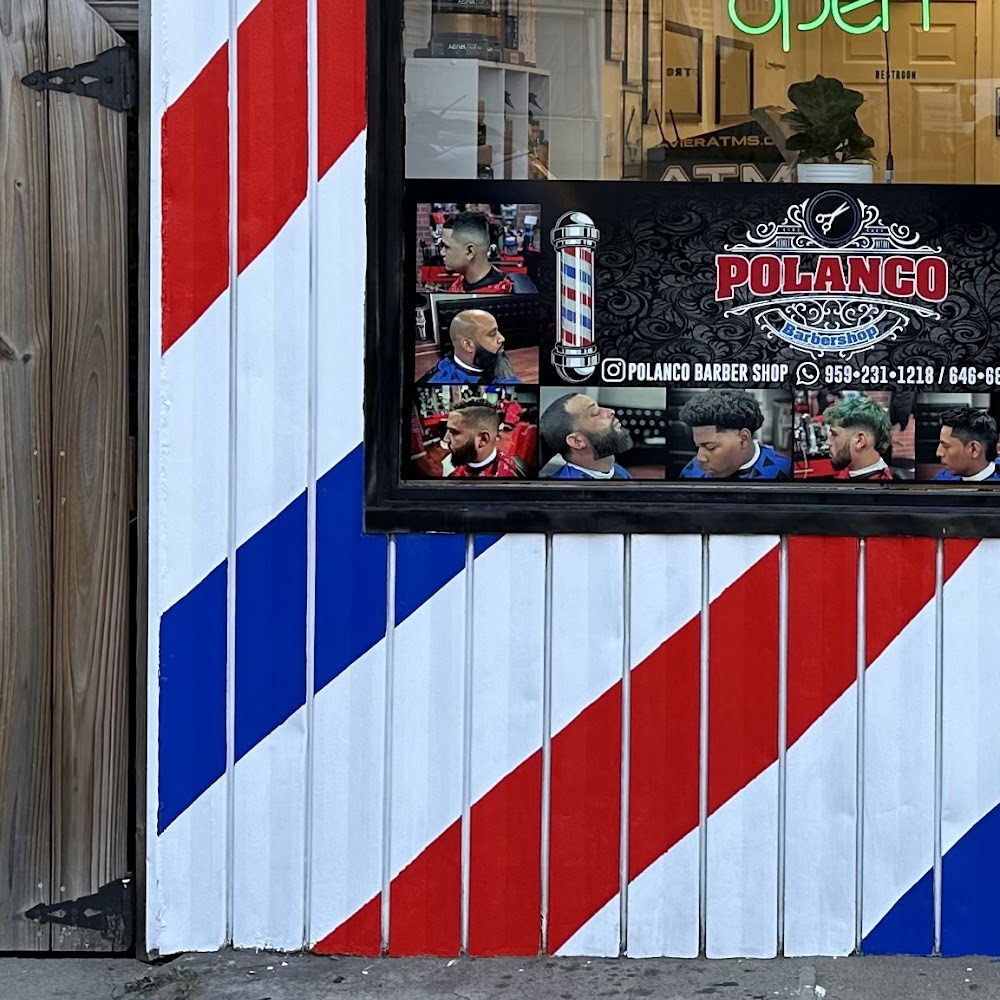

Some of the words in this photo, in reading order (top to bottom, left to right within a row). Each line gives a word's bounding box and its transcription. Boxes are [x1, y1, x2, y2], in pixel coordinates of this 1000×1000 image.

[875, 69, 916, 80] RESTROOM
[715, 254, 949, 303] POLANCO
[780, 322, 880, 346] Barbershop
[628, 361, 691, 382] POLANCO
[694, 362, 748, 382] BARBER
[752, 363, 789, 383] SHOP
